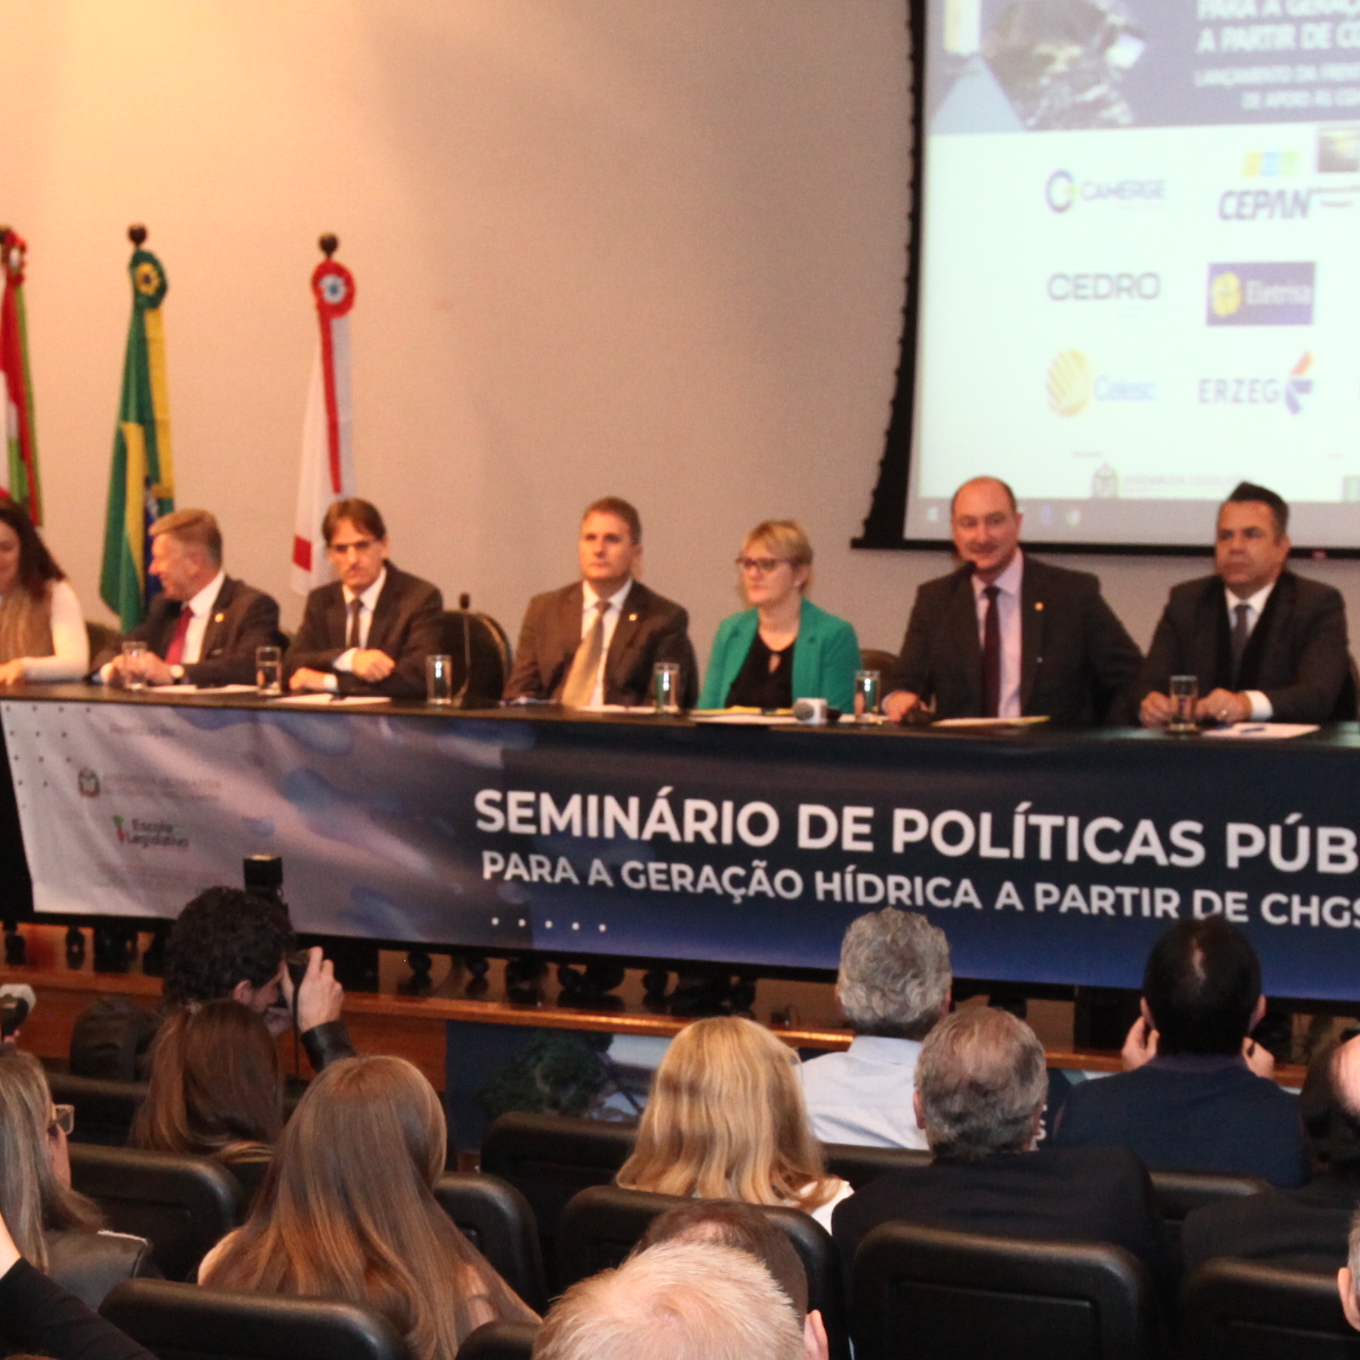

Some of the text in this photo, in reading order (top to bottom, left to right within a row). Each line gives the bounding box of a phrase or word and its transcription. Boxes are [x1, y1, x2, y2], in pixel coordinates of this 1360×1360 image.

[1196, 27, 1217, 53] A
[1220, 23, 1296, 52] PARTIR
[1300, 21, 1333, 50] DE
[1218, 189, 1313, 221] CEPAN
[1047, 272, 1161, 301] CEDRO
[1198, 379, 1280, 404] ERZEG
[474, 786, 780, 848] SEMINÁRIO
[797, 803, 875, 852] DE
[892, 801, 1206, 868] POLÍTICAS
[482, 850, 580, 885] PARA
[587, 859, 615, 887] A
[621, 860, 803, 904] GERAÇÃO
[815, 864, 982, 911] HÍDRICA
[994, 881, 1026, 911] A
[1035, 882, 1181, 919] PARTIR
[1193, 890, 1249, 922] DE
